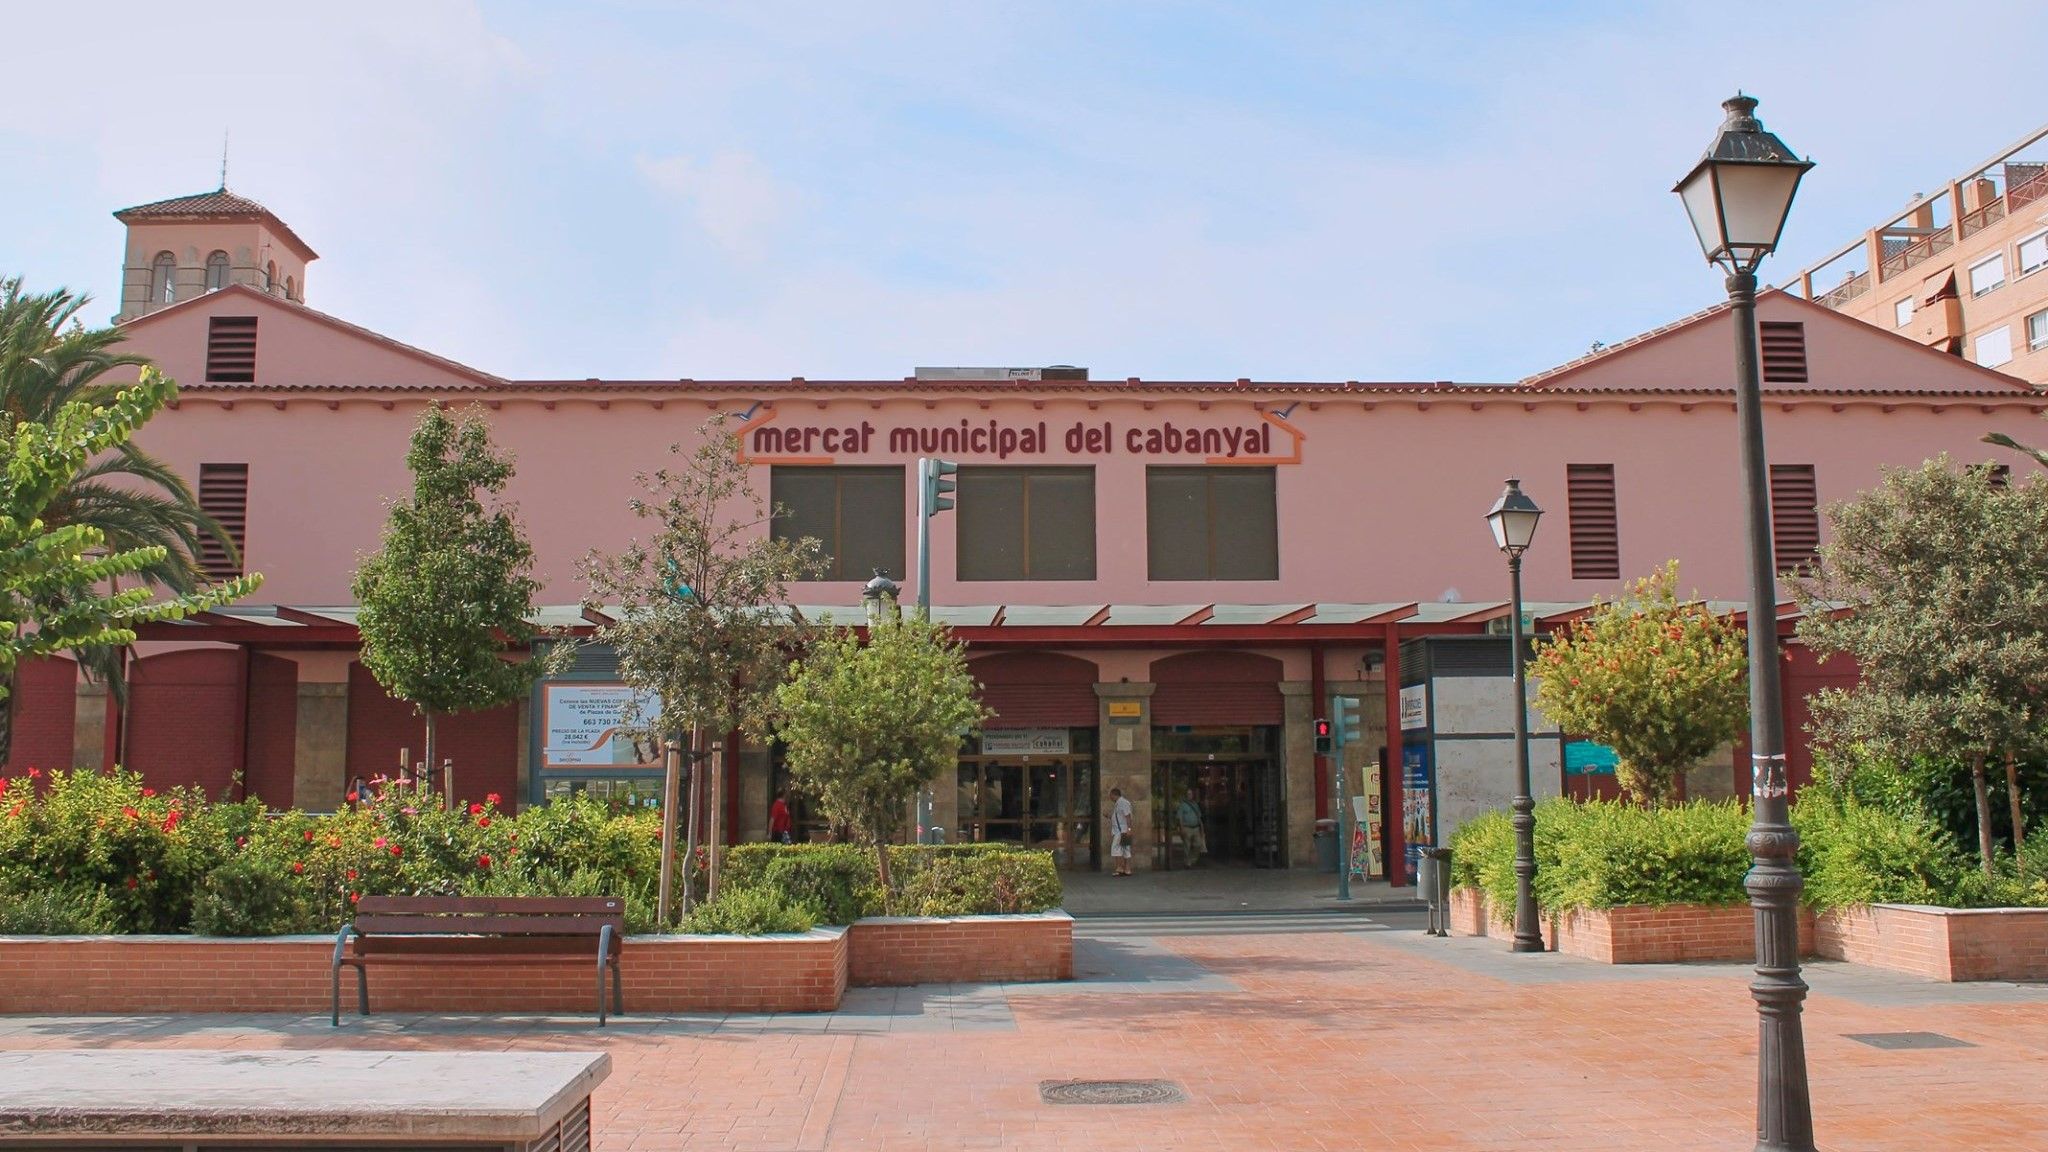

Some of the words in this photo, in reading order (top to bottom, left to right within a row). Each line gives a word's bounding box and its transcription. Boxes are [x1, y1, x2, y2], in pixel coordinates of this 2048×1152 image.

[753, 420, 875, 453] mercat
[889, 418, 1046, 460] municipal
[1065, 421, 1112, 454] del
[1126, 421, 1270, 457] cabanyal
[583, 718, 596, 726] 663
[598, 718, 611, 726] 730
